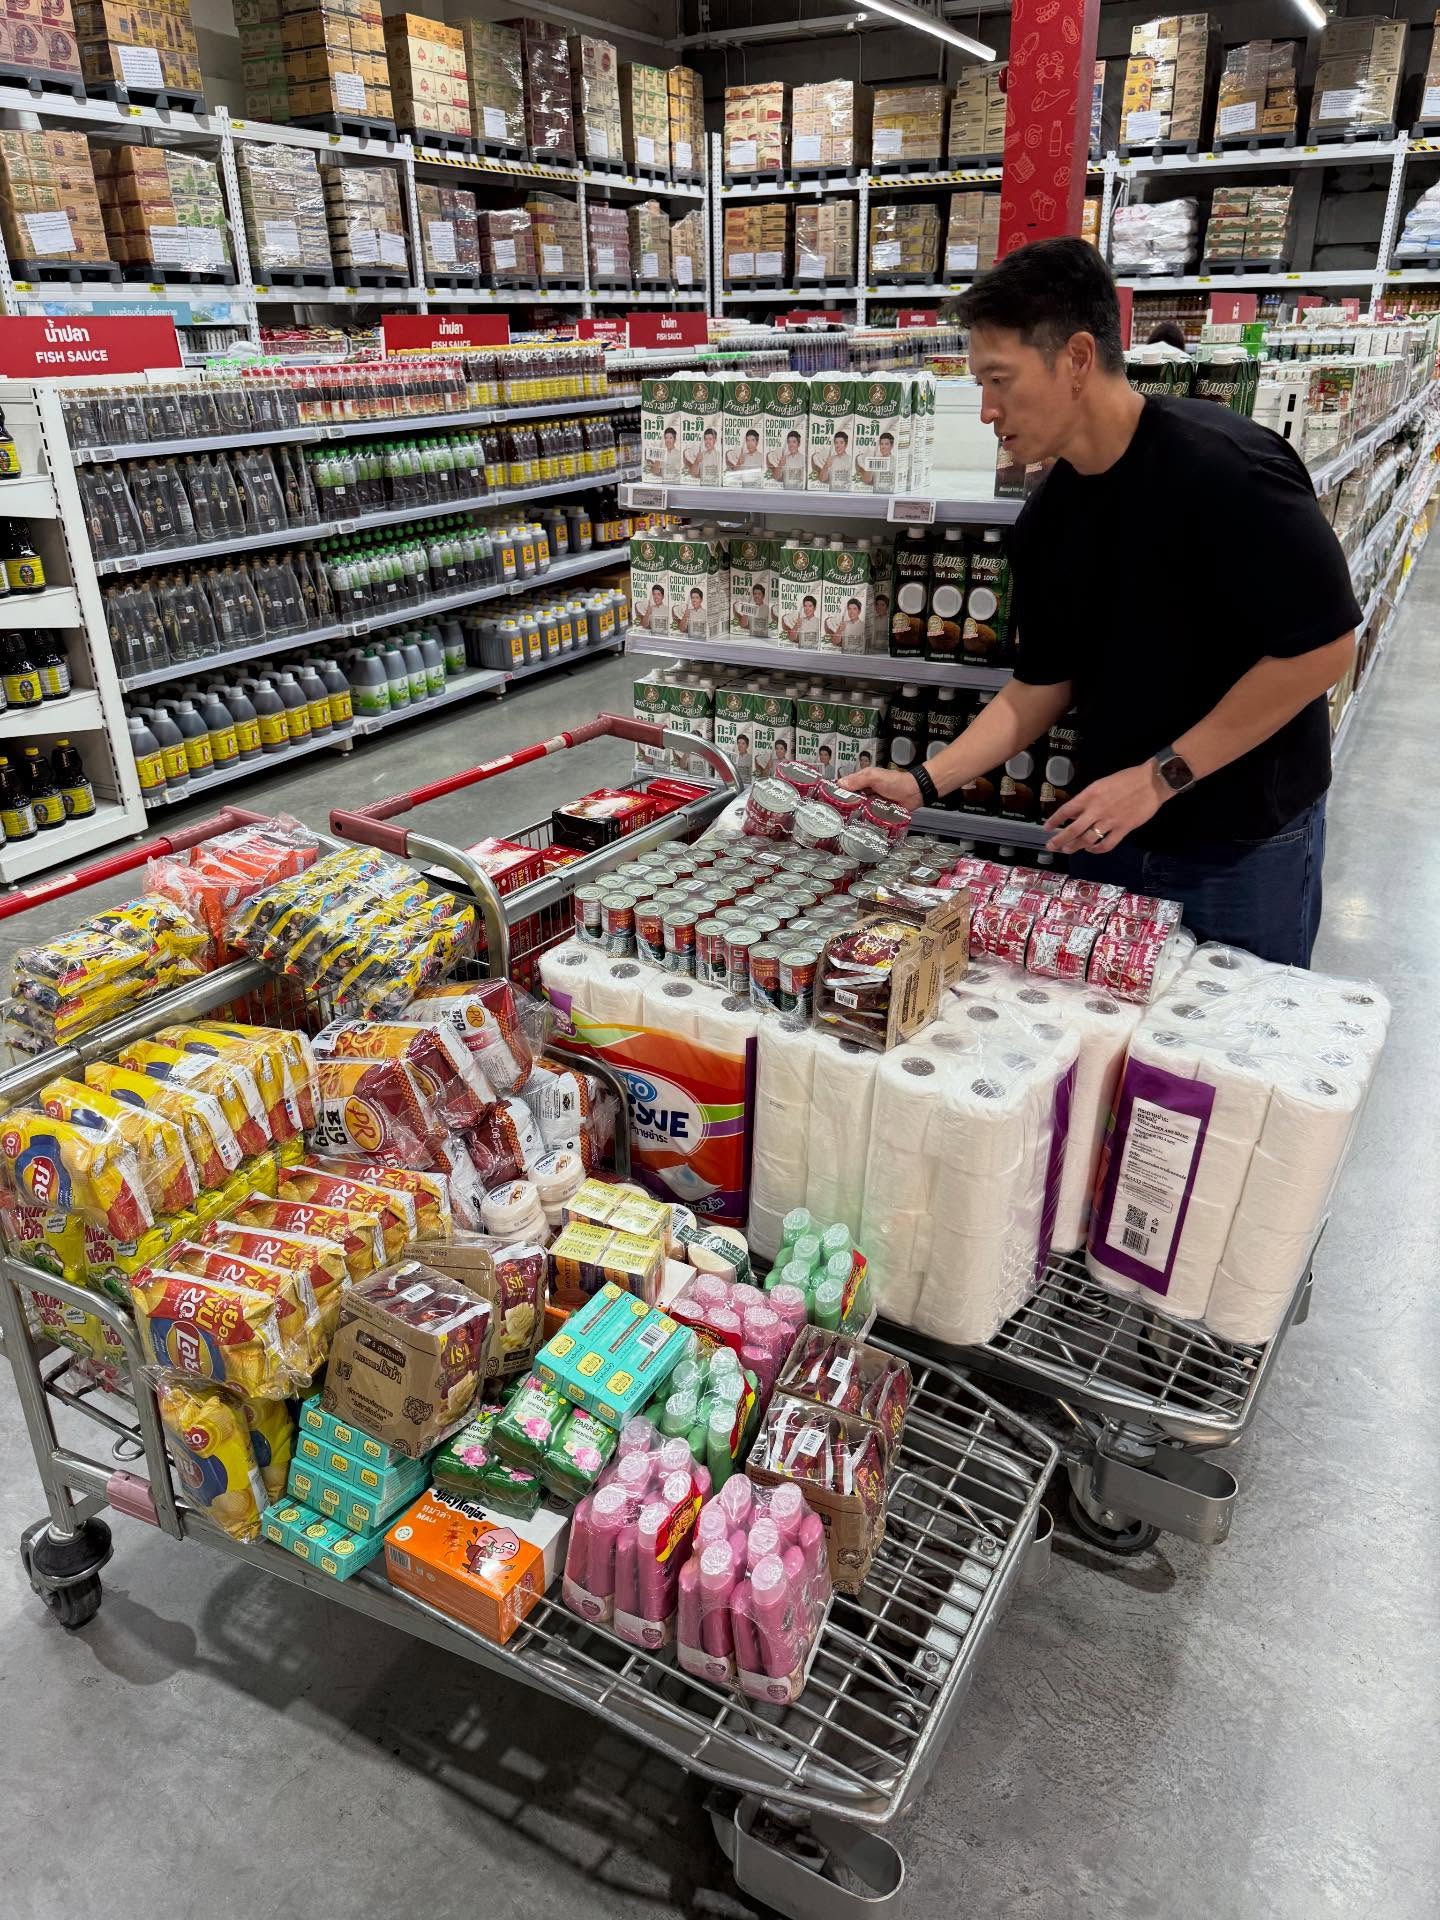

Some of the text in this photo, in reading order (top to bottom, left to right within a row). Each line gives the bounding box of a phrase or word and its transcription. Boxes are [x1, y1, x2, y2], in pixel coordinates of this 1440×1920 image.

[439, 317, 463, 335] น้ำปลา
[44, 319, 90, 343] น้ำปลา
[656, 333, 682, 341] FISH SAUCE
[35, 350, 108, 364] FISH SAUCE
[724, 418, 753, 428] COCONUT
[765, 419, 795, 428] COCONUT
[644, 432, 662, 440] 100%
[724, 428, 740, 436] MILK
[766, 429, 782, 437] MILK
[683, 433, 701, 441] 100%
[725, 437, 740, 446] 100%
[812, 436, 831, 445] 100%
[856, 437, 876, 446] 100%
[766, 438, 781, 447] 100%
[633, 573, 658, 582] COCONUT
[670, 576, 697, 585] COCONUT
[633, 581, 647, 590] MILK
[670, 585, 685, 593] MILK
[782, 584, 811, 594] COCONUT
[634, 590, 647, 598] 100%
[733, 587, 750, 595] 100%
[825, 587, 855, 596] COCONUT
[670, 593, 685, 601] 100%
[825, 596, 841, 604] MILK
[782, 602, 797, 610] 100%
[825, 605, 841, 613] 100%
[717, 736, 735, 744] 100%
[754, 741, 773, 750] 100%
[799, 747, 817, 756] 100%
[838, 752, 857, 761] 100%
[326, 1108, 348, 1146] Big
[347, 1105, 377, 1145] PR
[5, 1137, 19, 1156] 20
[575, 1418, 606, 1439] PARROT
[457, 1498, 487, 1521] Konjac
